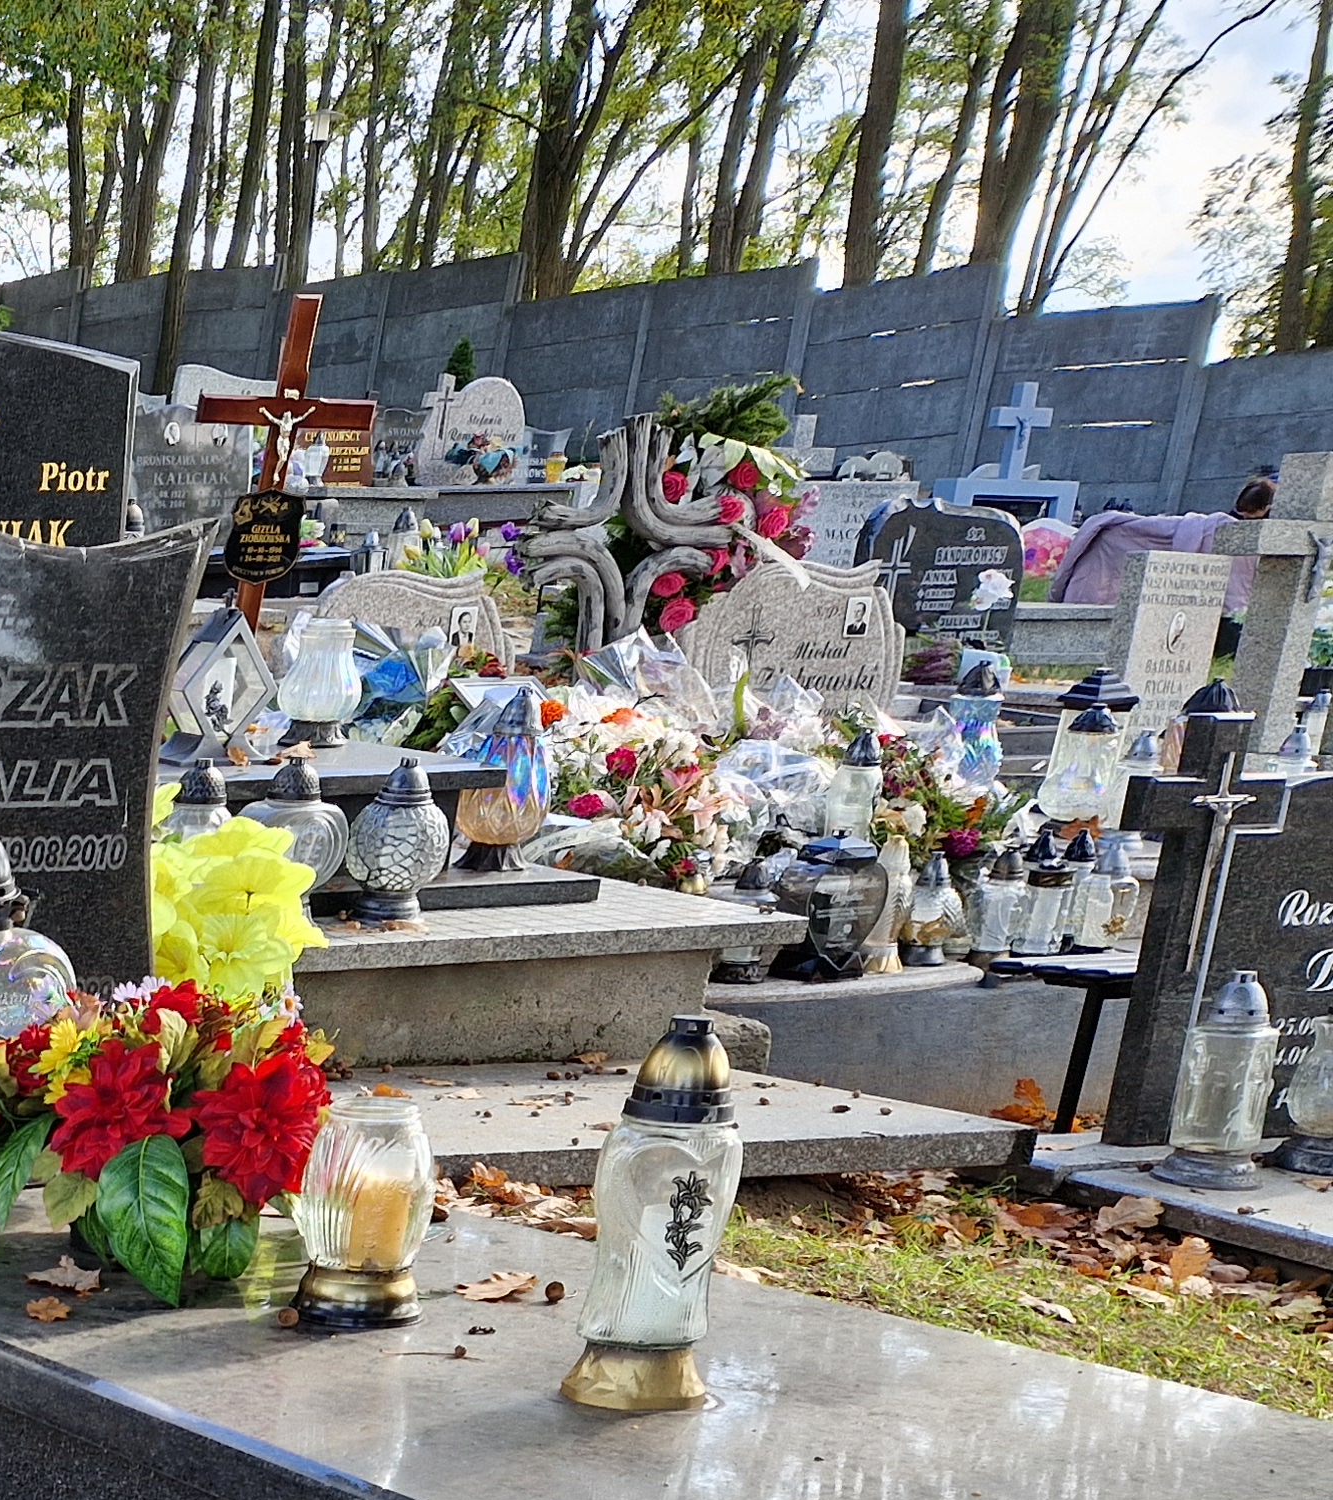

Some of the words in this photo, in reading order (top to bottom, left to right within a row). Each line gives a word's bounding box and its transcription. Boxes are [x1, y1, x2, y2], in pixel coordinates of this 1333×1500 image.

[38, 460, 111, 492] Piotr
[919, 568, 958, 586] ANNA
[937, 614, 982, 629] JULIAN
